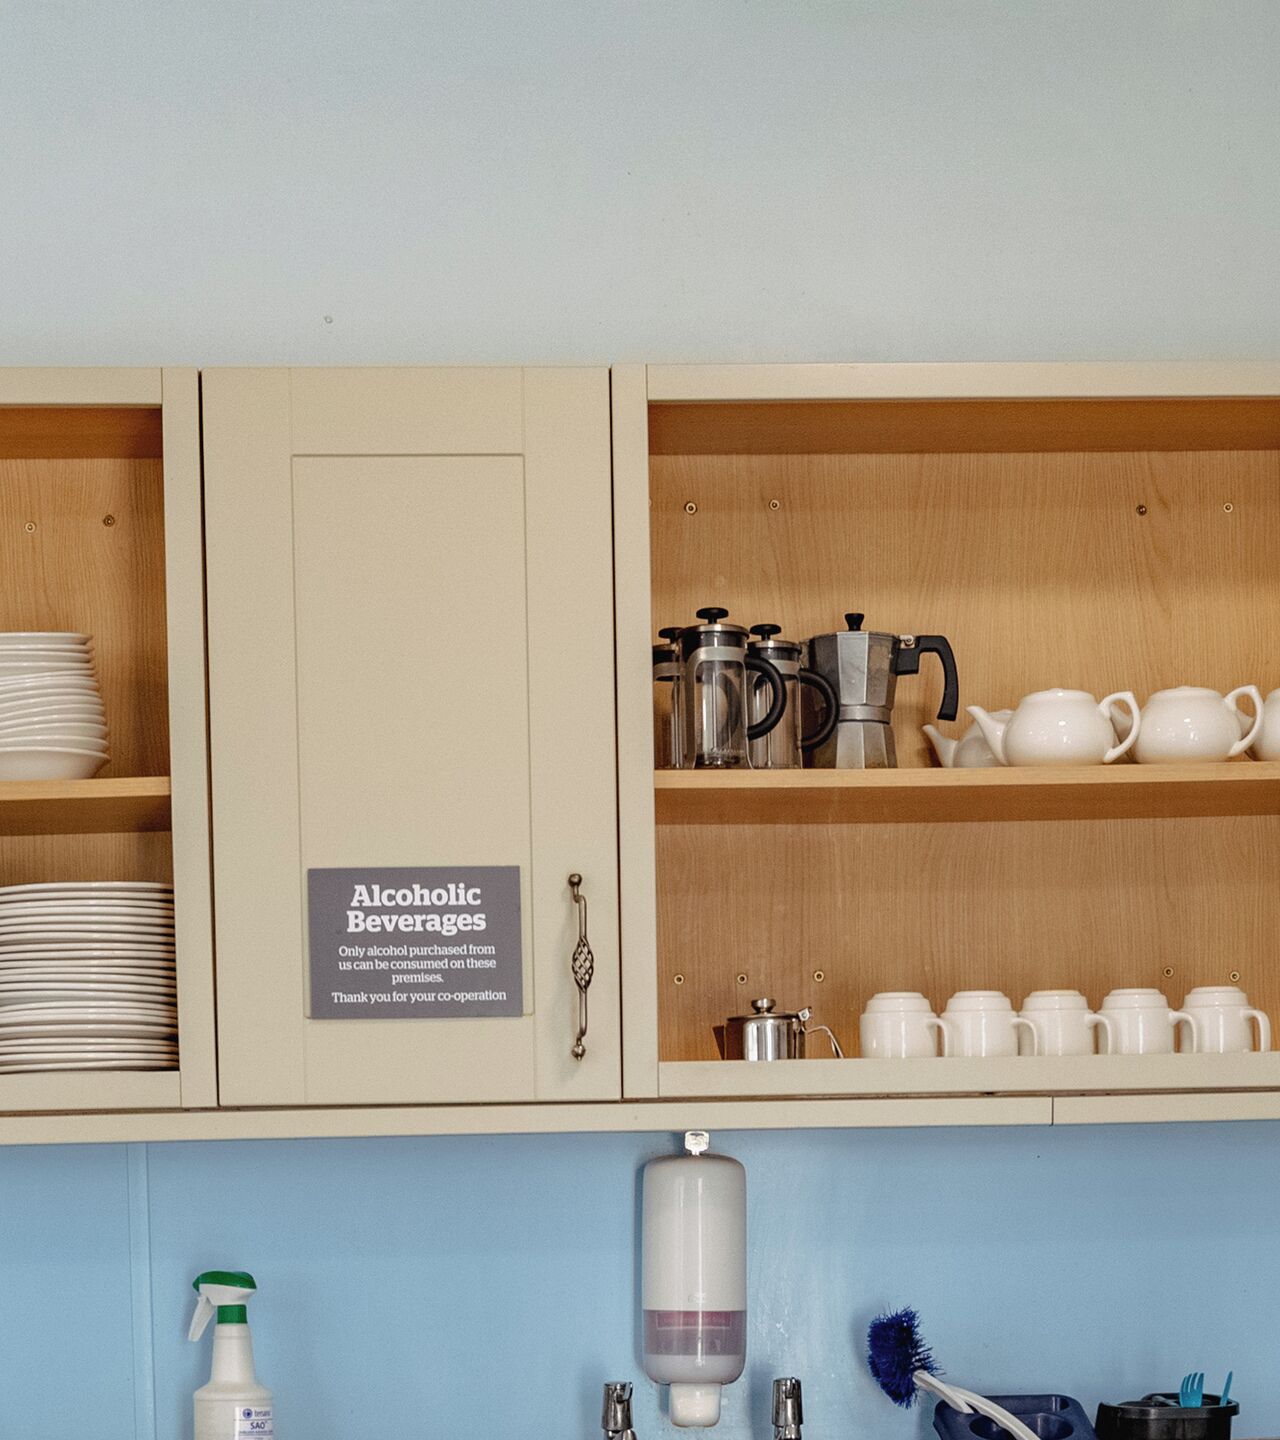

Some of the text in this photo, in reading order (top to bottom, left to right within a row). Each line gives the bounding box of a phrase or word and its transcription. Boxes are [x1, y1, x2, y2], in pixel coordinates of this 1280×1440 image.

[350, 882, 481, 907] Alcoholic
[346, 910, 487, 936] Beverages
[338, 944, 496, 958] Only alcohol purchased from
[338, 957, 496, 970] us can be consumed on these
[391, 971, 444, 985] premises.
[331, 990, 507, 1004] Thank you for your co-operation
